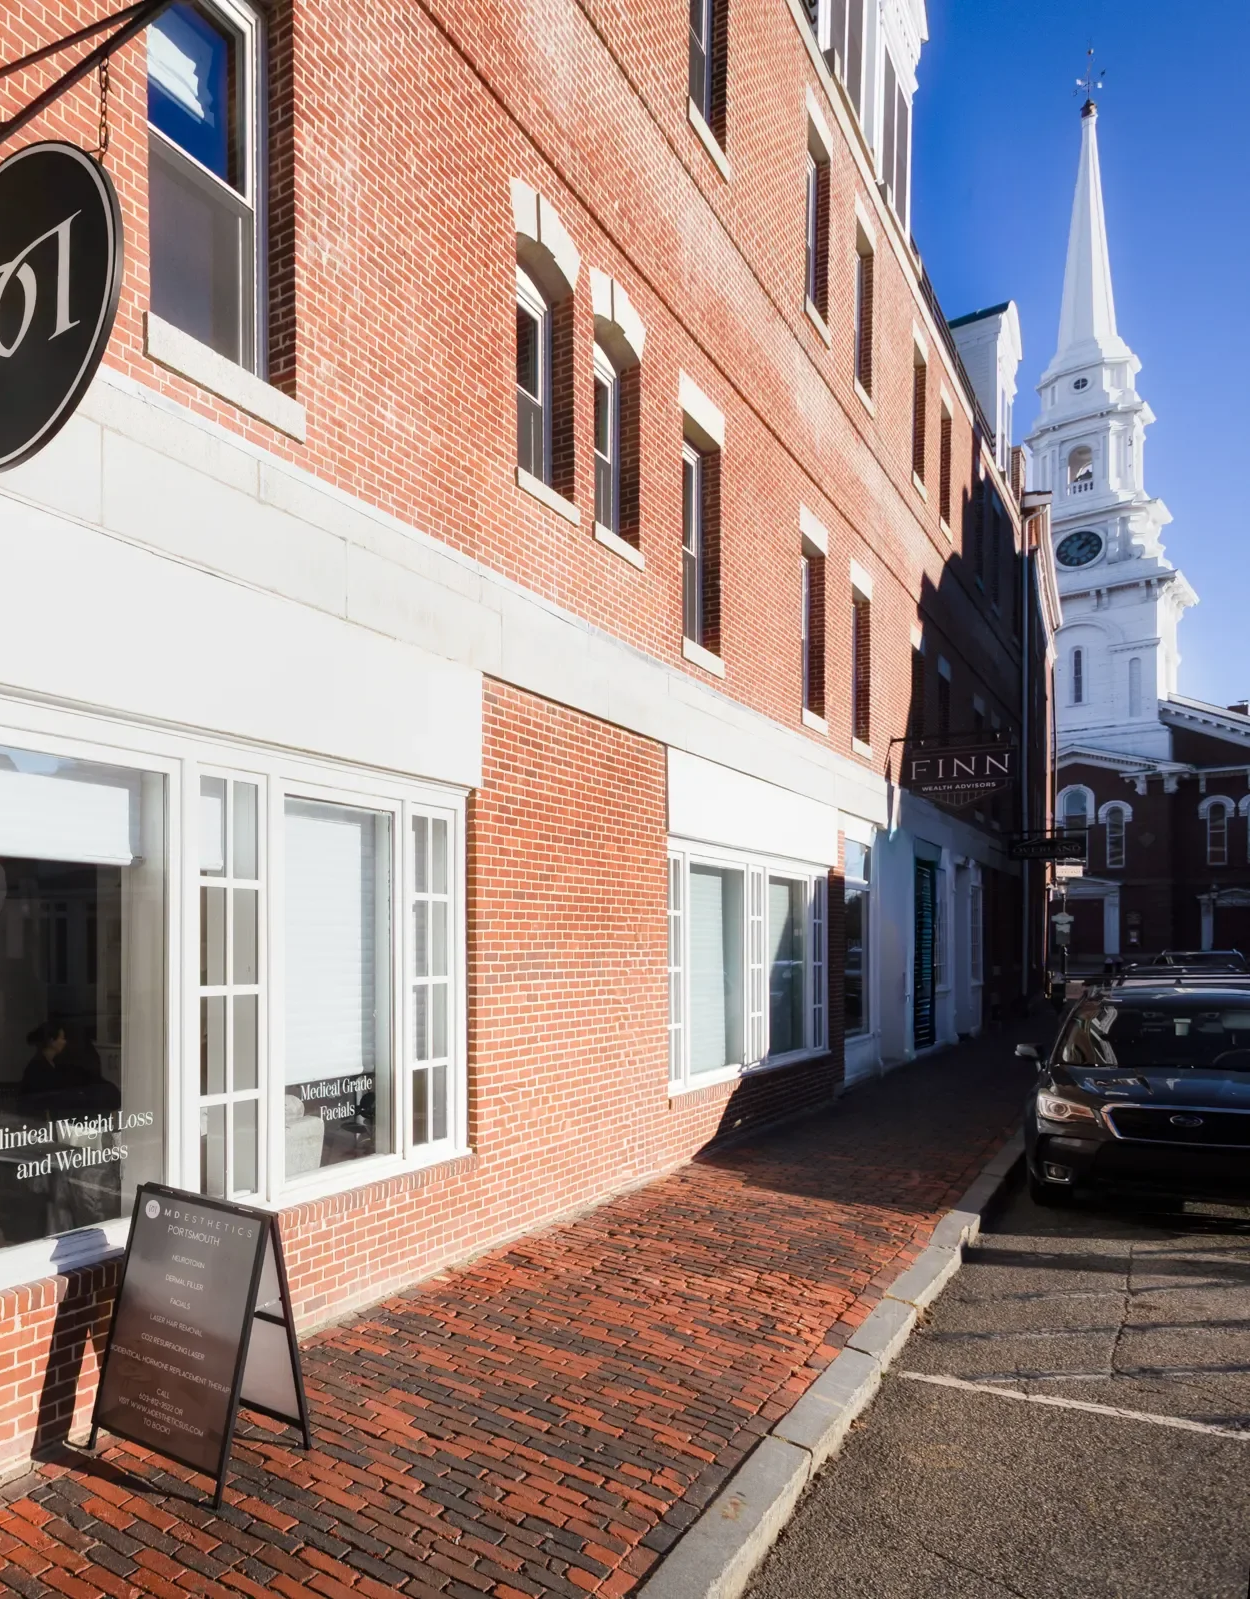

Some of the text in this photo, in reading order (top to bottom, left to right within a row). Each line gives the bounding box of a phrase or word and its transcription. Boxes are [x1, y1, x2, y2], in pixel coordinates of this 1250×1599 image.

[911, 753, 1010, 780] FINN
[922, 781, 996, 792] WEALTH ADVISORS
[300, 1075, 372, 1101] Medical Grade
[320, 1101, 355, 1122] Facials
[56, 1113, 114, 1141] Weight
[118, 1109, 154, 1131] Loss
[16, 1144, 128, 1180] and Wellness
[167, 1224, 220, 1246] PORTSMOUTH
[172, 1254, 205, 1269] NEUROTOXIN
[165, 1273, 204, 1291] DERMAL FILLER
[170, 1297, 190, 1310] FACIALS
[150, 1313, 203, 1338] LASER HAIR REMOVAL
[141, 1332, 205, 1361] CO2 RESURFACING LASER
[142, 1355, 169, 1371] HORMONE
[169, 1365, 207, 1386] REPLACEMENT
[118, 1396, 130, 1406] VISIT
[156, 1388, 170, 1400] CALL
[143, 1417, 152, 1427] TO
[174, 1407, 184, 1417] OR
